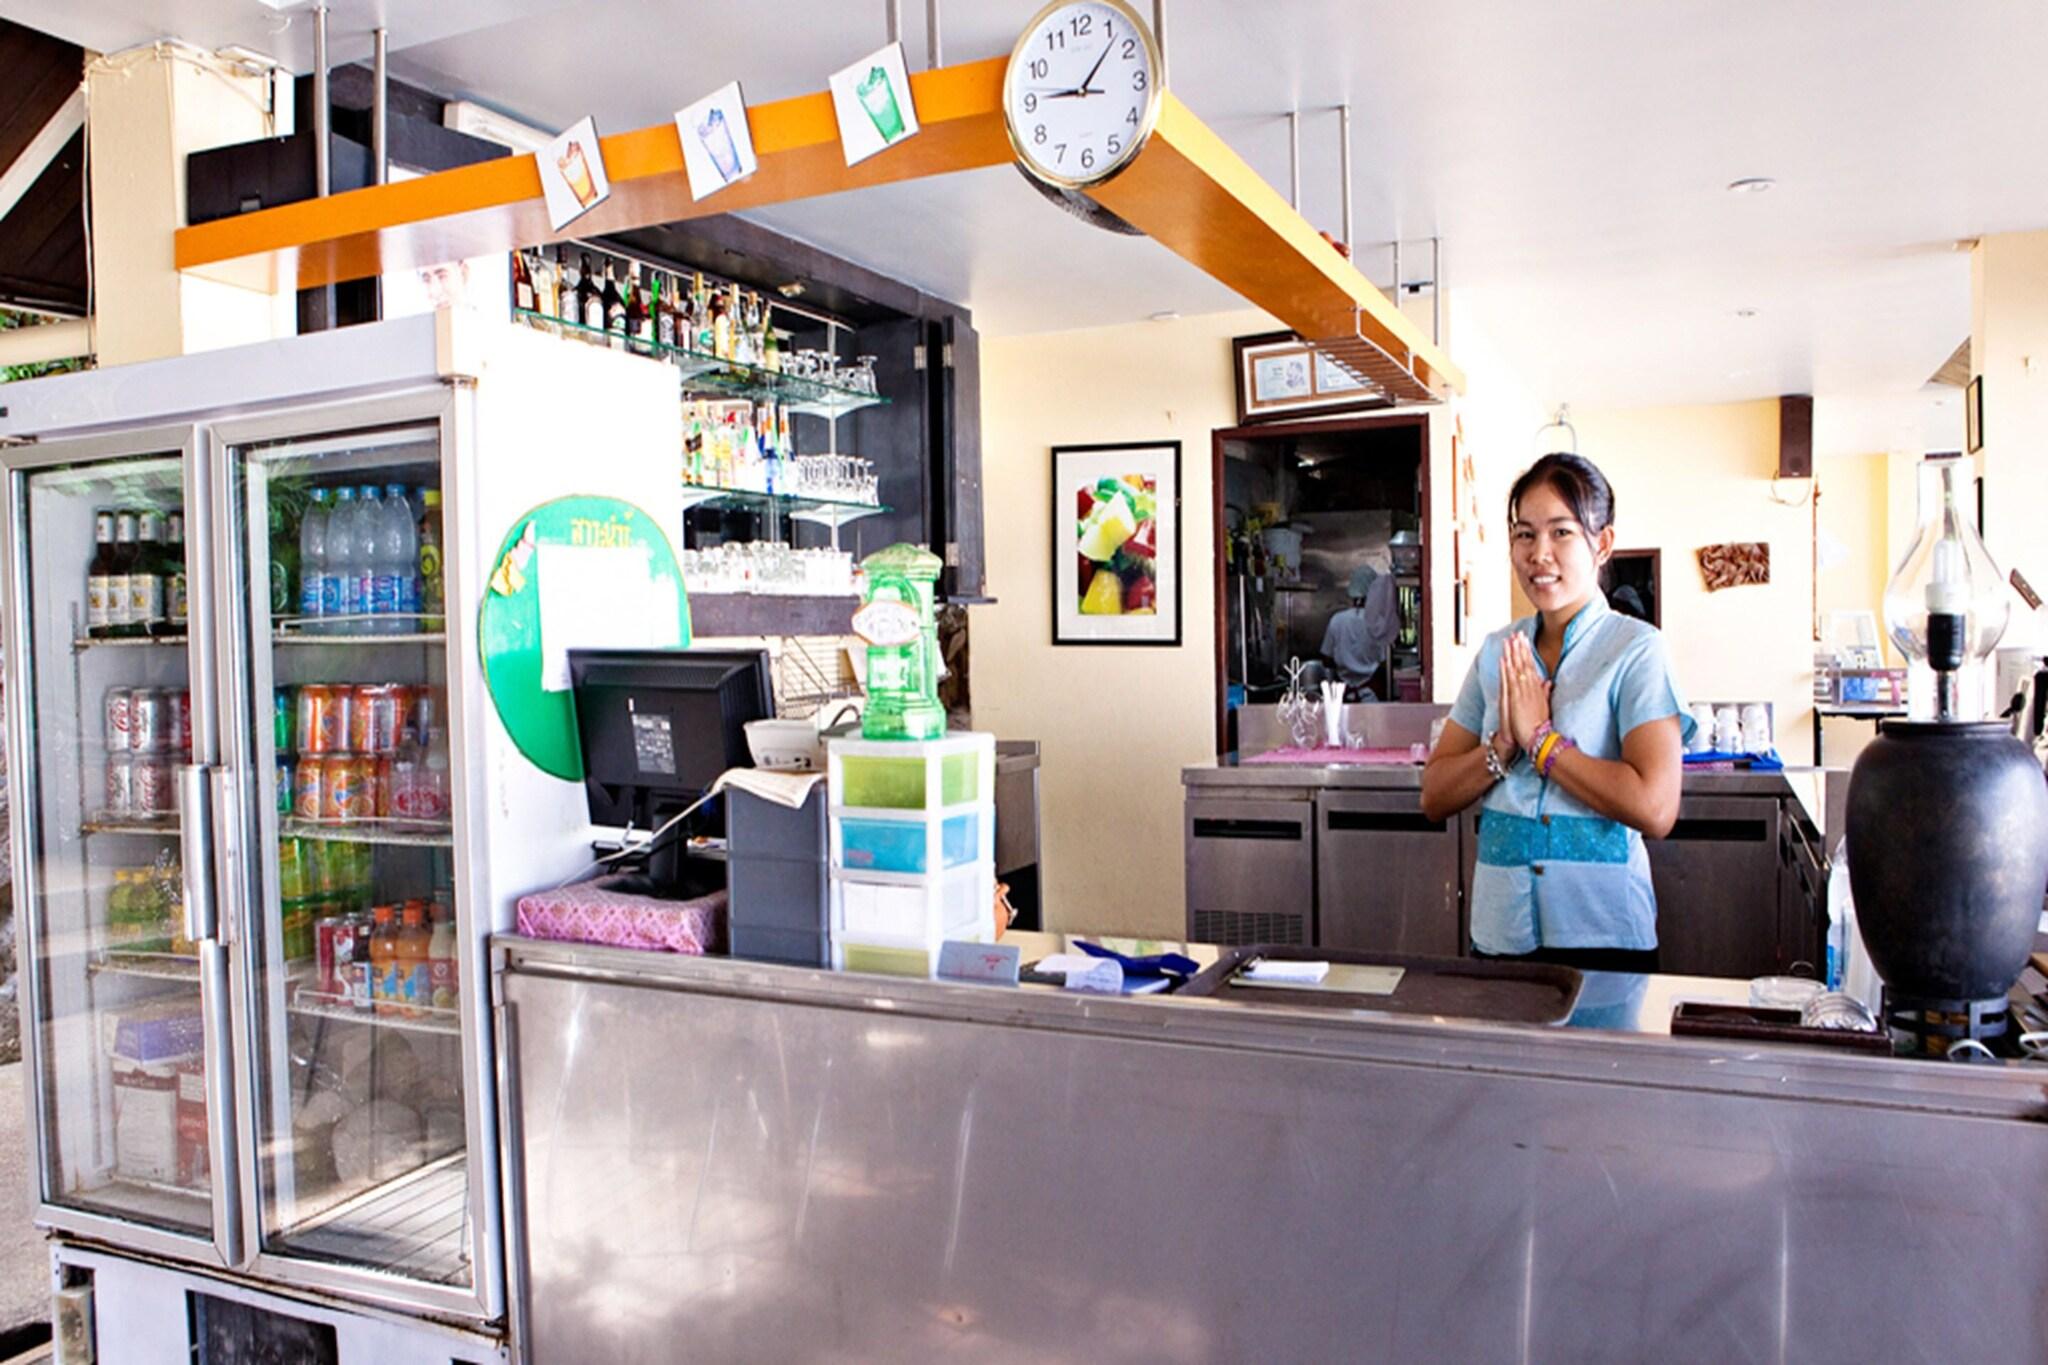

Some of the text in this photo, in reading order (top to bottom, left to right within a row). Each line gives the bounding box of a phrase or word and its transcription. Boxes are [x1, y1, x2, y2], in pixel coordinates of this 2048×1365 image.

[1070, 14, 1092, 36] 12
[1104, 20, 1112, 38] 1
[1047, 30, 1065, 50] 11
[1121, 39, 1136, 60] 2
[1029, 58, 1048, 79] 10
[1132, 70, 1147, 91] 3
[1024, 93, 1037, 113] 9
[1125, 107, 1138, 126] 4
[1034, 124, 1047, 144] 8
[1107, 134, 1121, 154] 5
[1054, 143, 1067, 164] 7
[1081, 148, 1094, 169] 6
